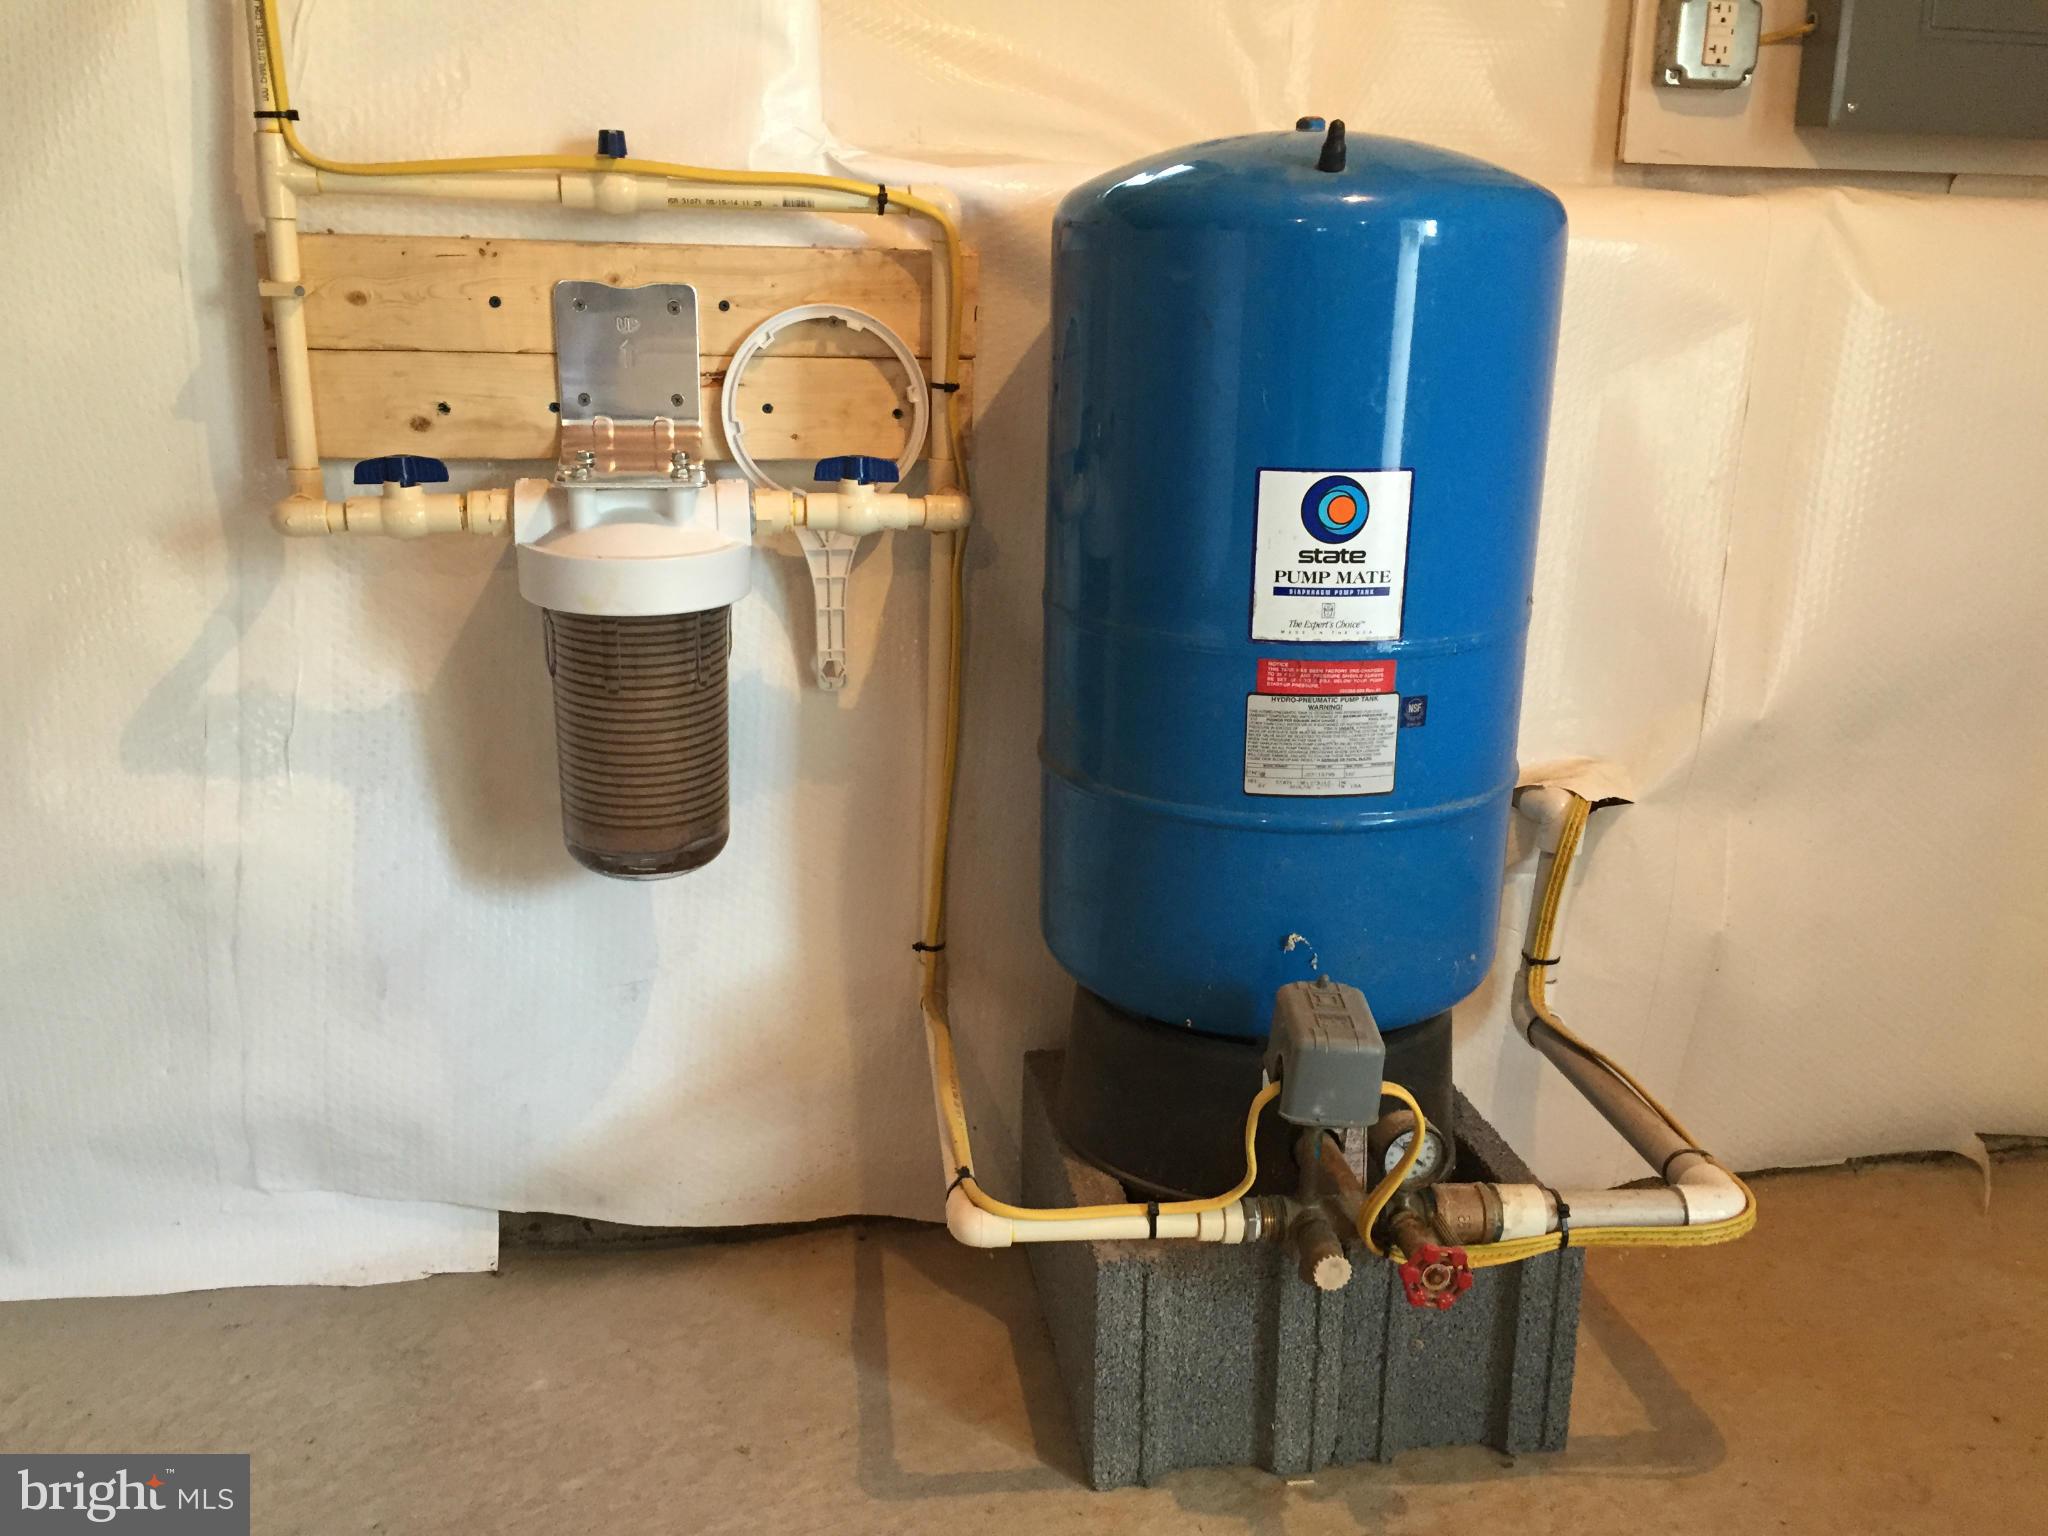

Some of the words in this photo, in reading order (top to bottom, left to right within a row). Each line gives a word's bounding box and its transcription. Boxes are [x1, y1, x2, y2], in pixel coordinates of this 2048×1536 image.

[616, 316, 641, 334] UP
[1298, 548, 1366, 564] state
[1274, 570, 1331, 585] PUMP
[1336, 570, 1392, 585] MATE
[1289, 588, 1331, 596] DIAPHRAGM
[1288, 619, 1303, 629] The
[1304, 620, 1334, 630] Expert's
[1408, 702, 1423, 713] NSF
